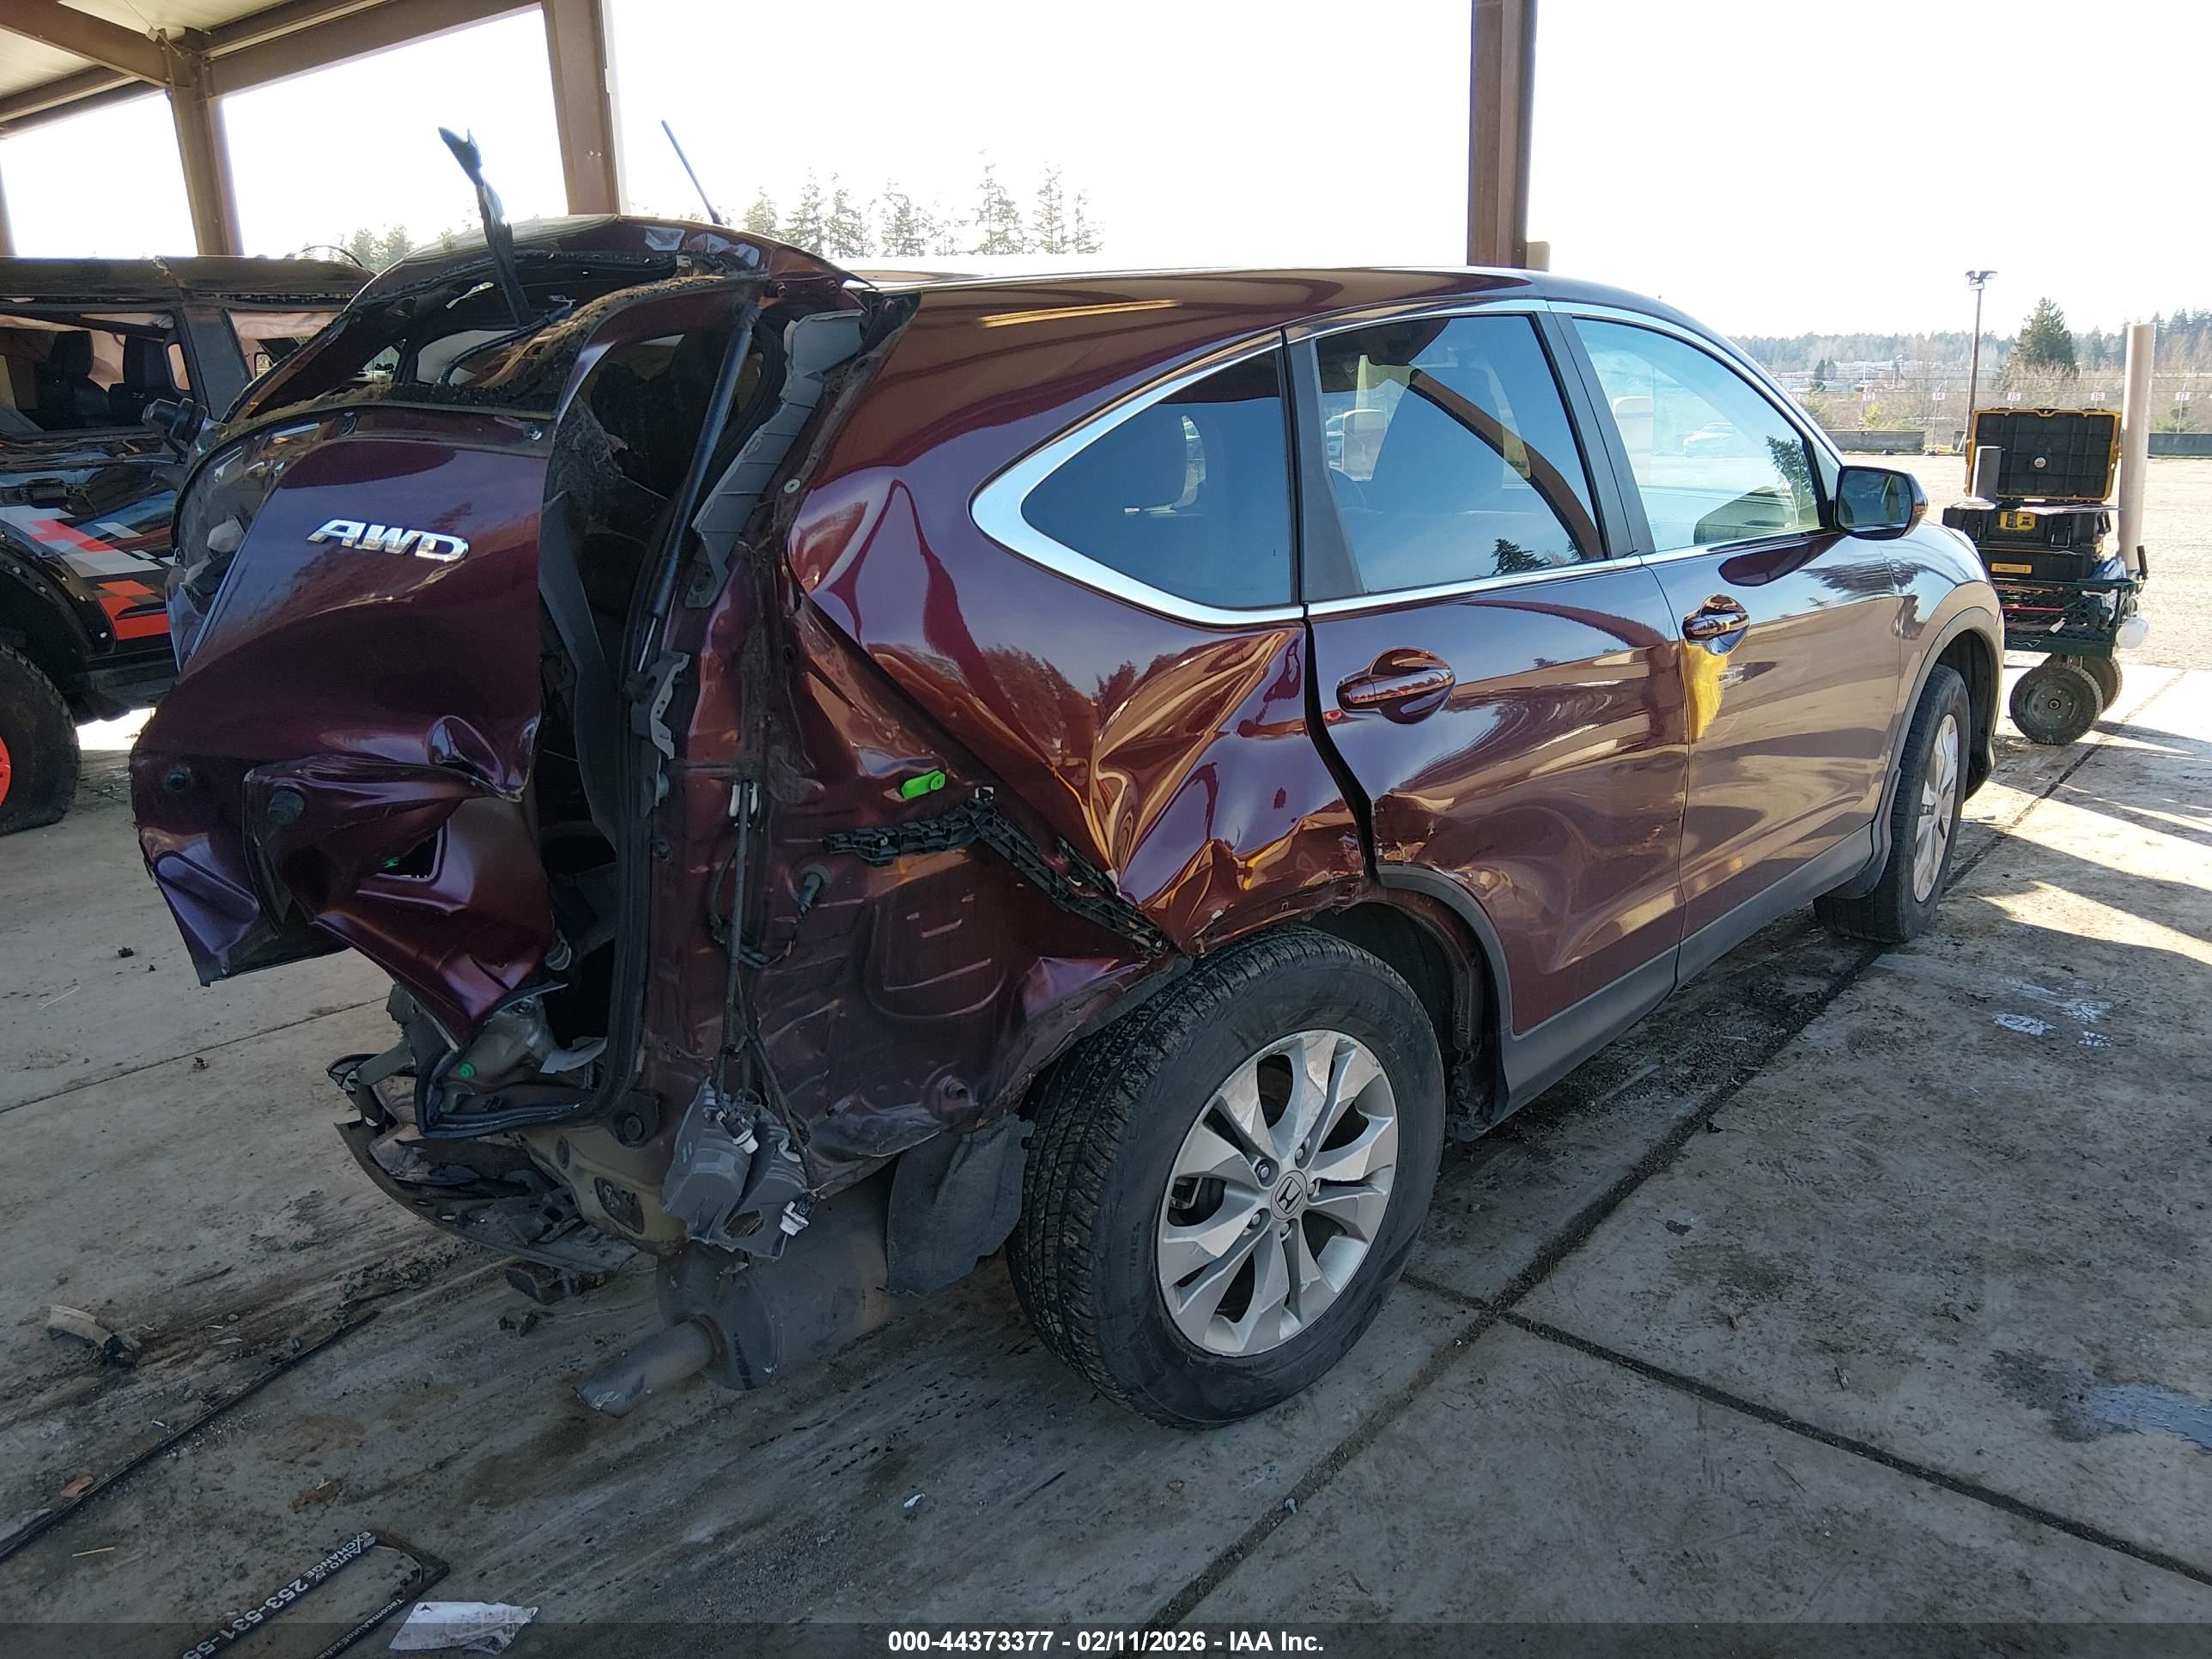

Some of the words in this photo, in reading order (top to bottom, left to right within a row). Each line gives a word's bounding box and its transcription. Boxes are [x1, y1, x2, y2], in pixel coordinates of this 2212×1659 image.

[307, 519, 469, 562] AWD
[303, 1532, 371, 1578] EXCHANGE
[330, 1546, 361, 1569] AUTO
[315, 1598, 405, 1659] TacomaAutoExcha
